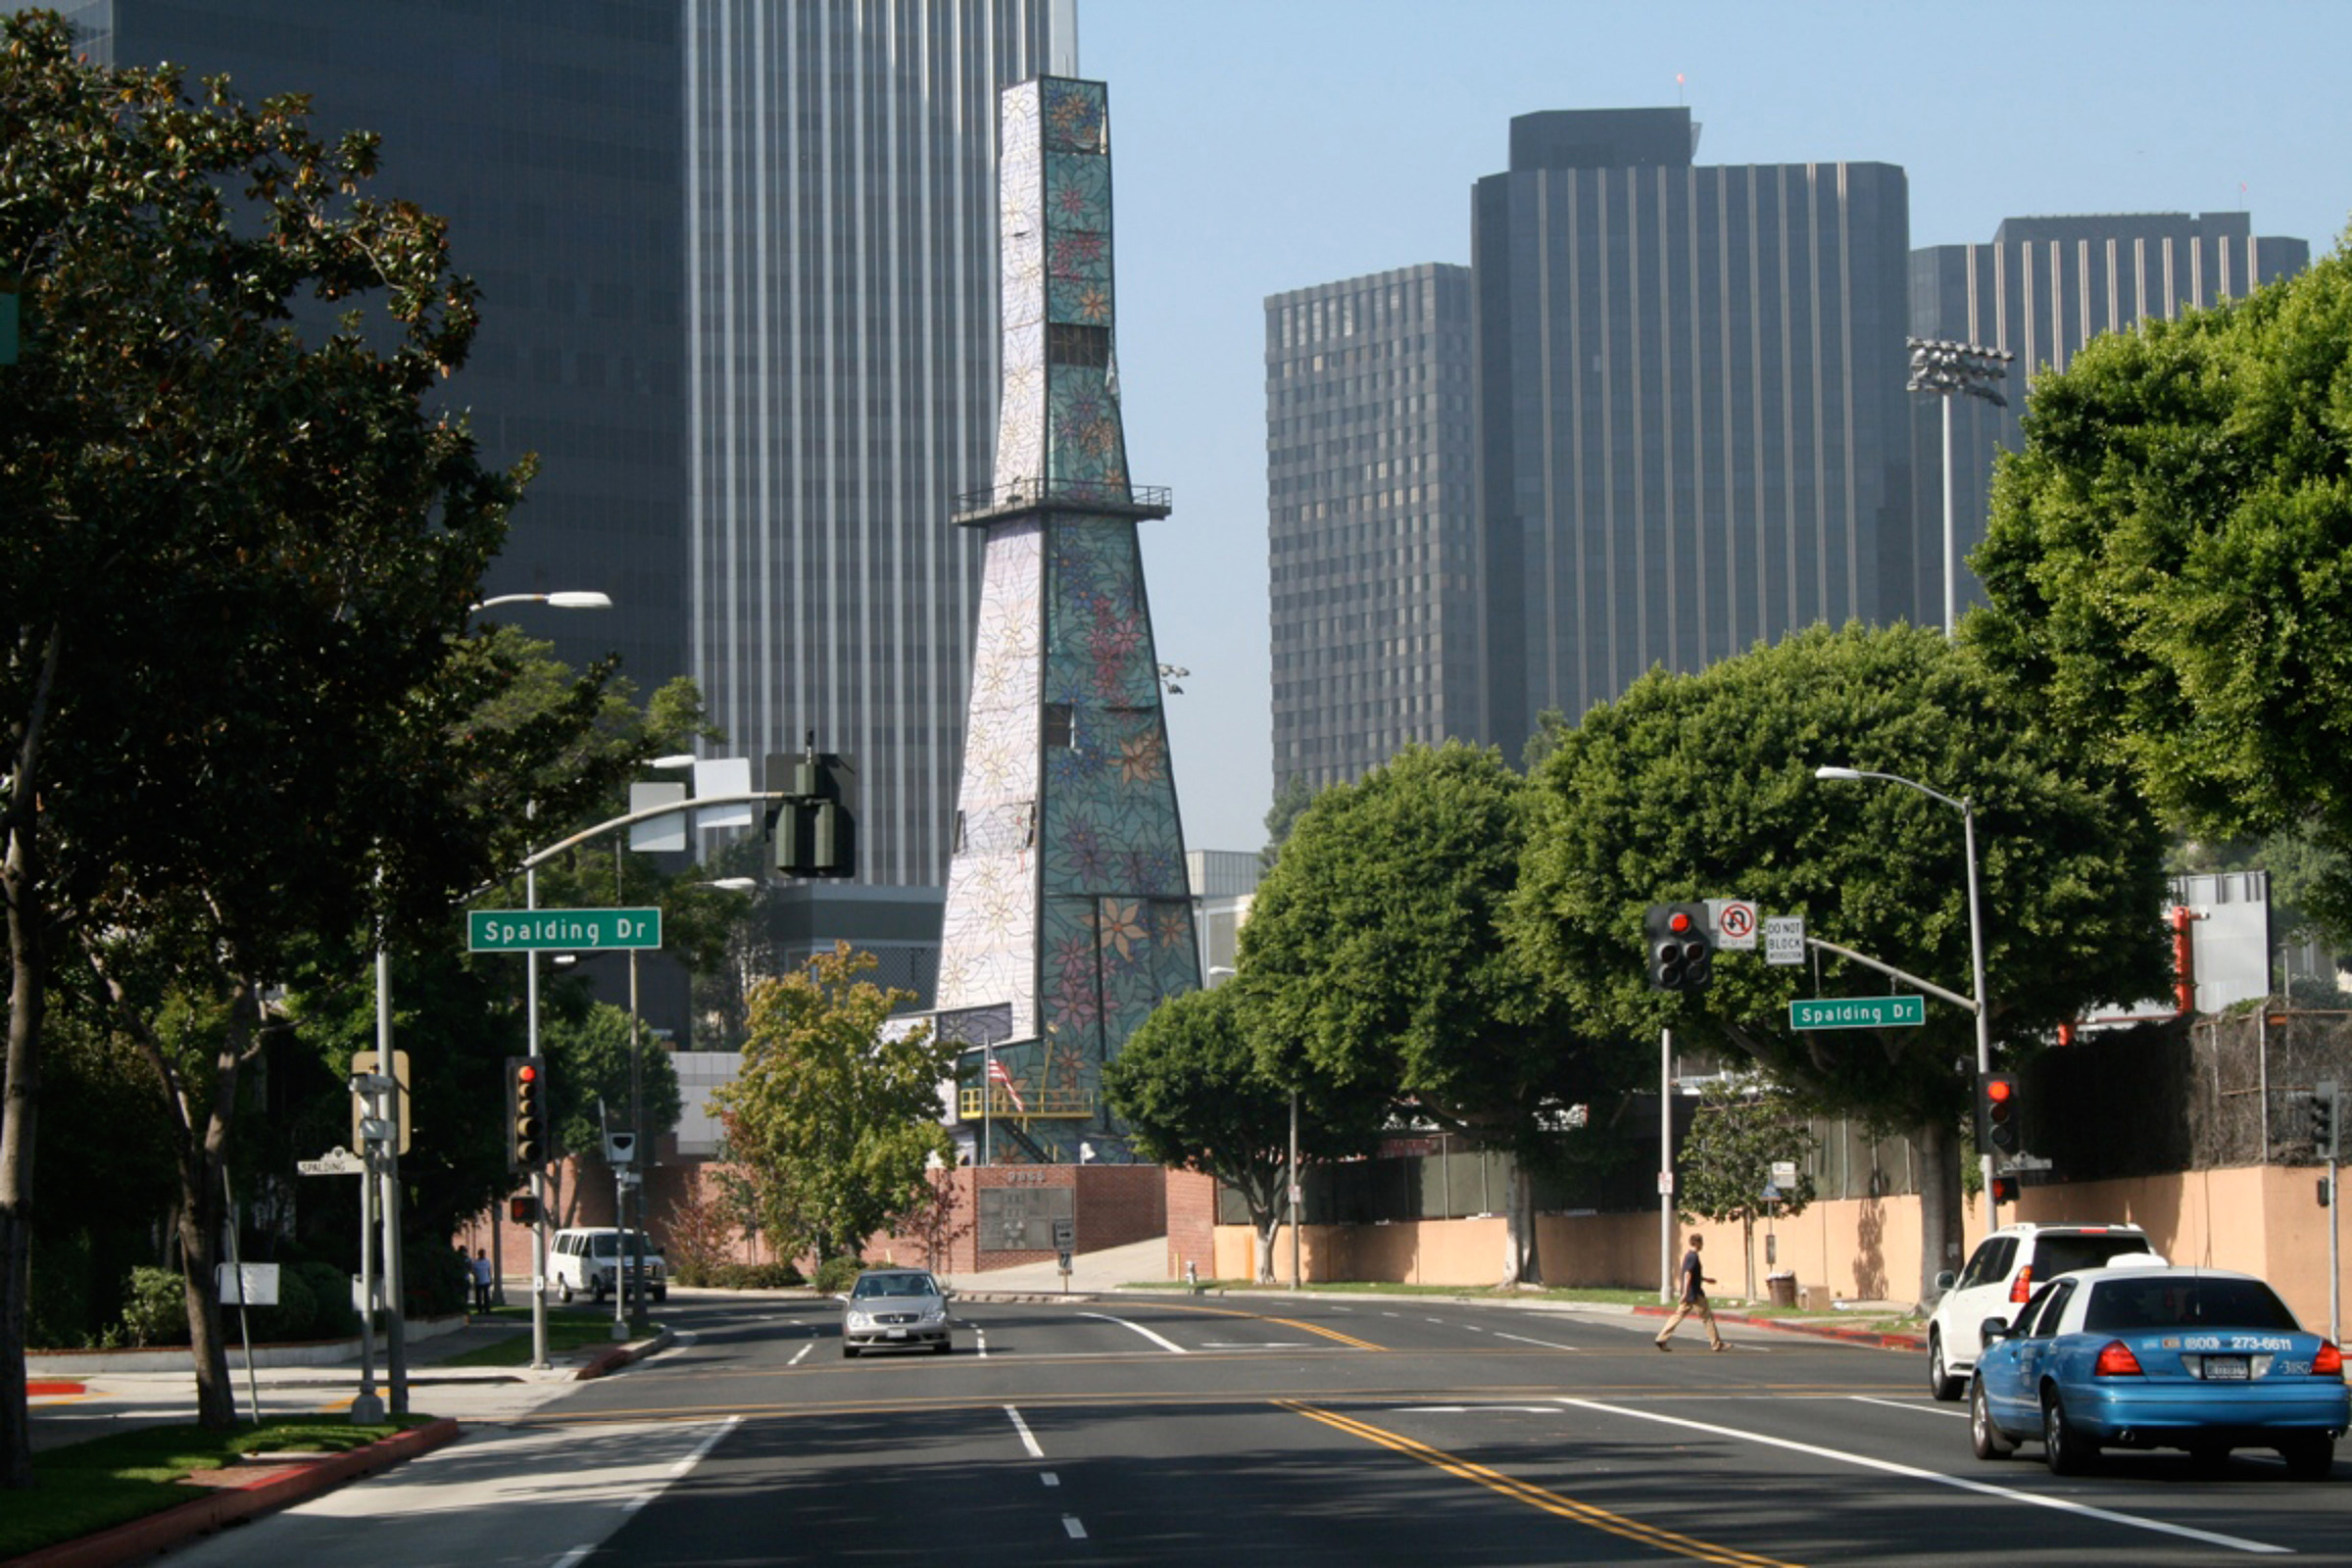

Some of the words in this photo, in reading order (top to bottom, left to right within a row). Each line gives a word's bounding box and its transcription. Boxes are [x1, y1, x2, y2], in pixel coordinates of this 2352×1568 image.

[484, 919, 599, 947] Spalding
[616, 918, 646, 939] Dr
[1768, 922, 1781, 934] DO
[1784, 922, 1799, 934] NOT
[1769, 938, 1802, 950] BLOCK
[1801, 1004, 1882, 1024] Spalding
[1892, 1004, 1914, 1018] Dr
[301, 1161, 346, 1173] SPALDING
[2184, 1336, 2220, 1349] (800)
